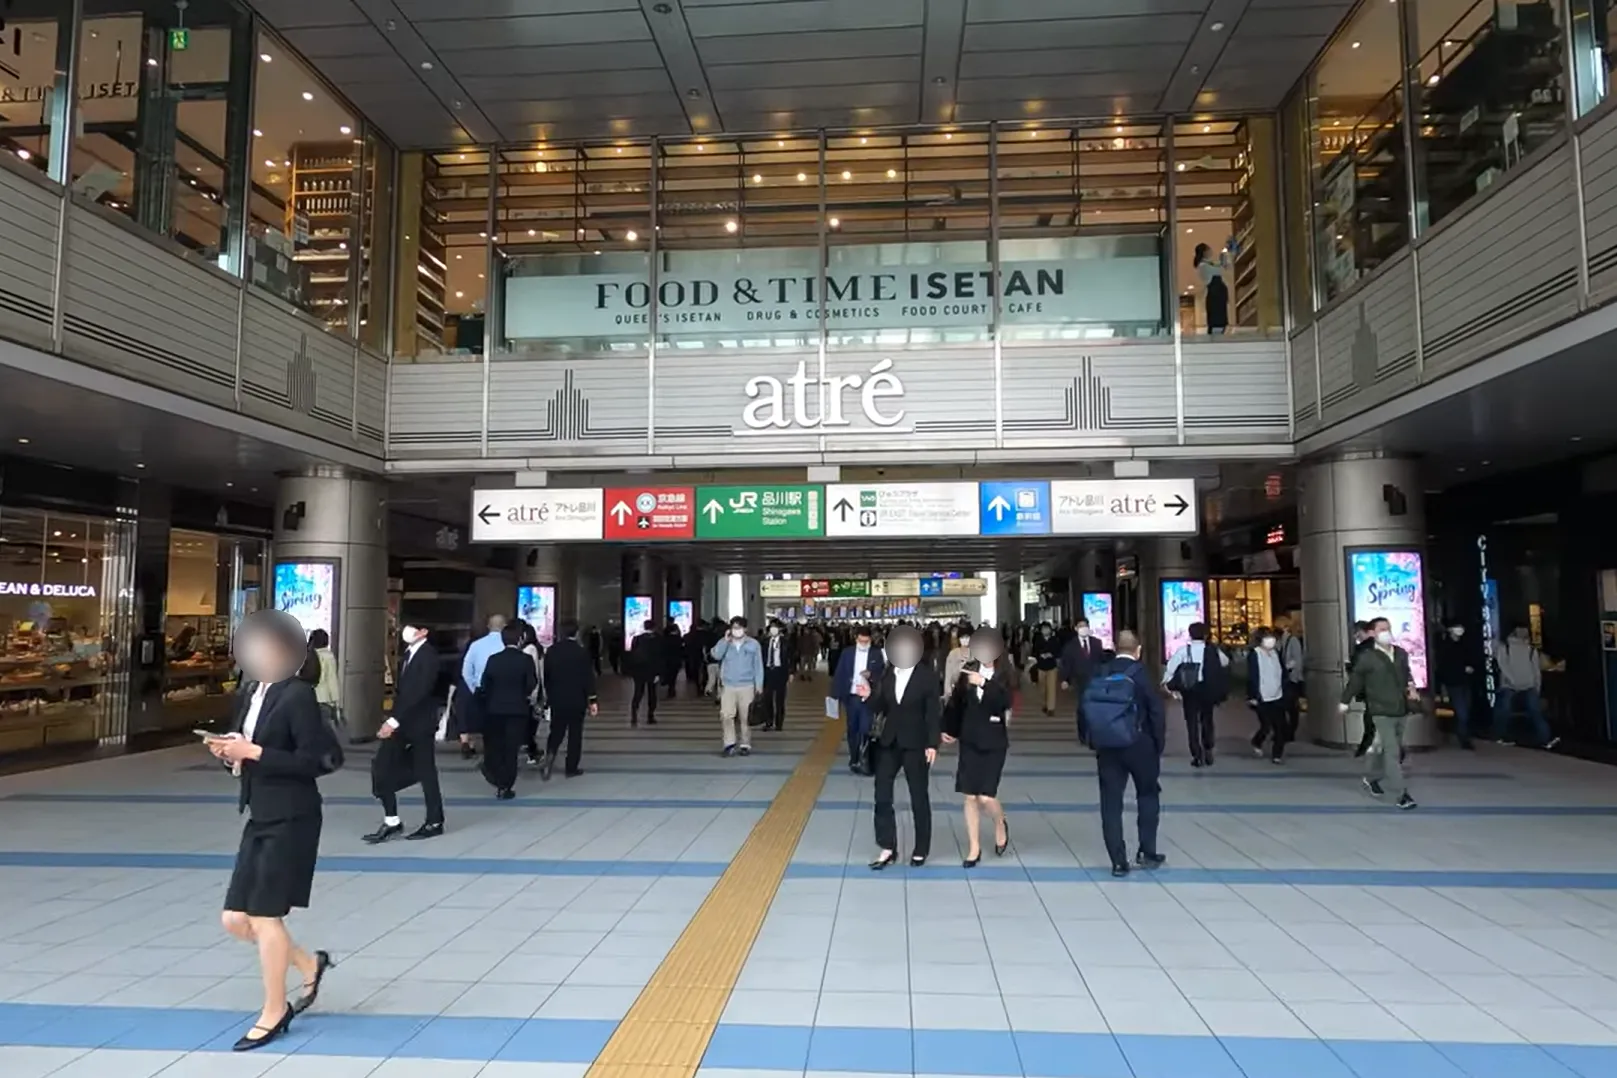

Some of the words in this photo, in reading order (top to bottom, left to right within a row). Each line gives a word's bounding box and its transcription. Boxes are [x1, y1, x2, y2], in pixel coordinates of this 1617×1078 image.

[594, 280, 719, 310] FOOD
[733, 278, 763, 305] &
[768, 273, 897, 304] TIME
[909, 269, 1064, 300] ISETAN
[747, 310, 782, 320] DRUG
[790, 310, 798, 320] &
[806, 307, 880, 319] COSMETICS
[902, 304, 938, 316] FOOD
[944, 304, 987, 316] COURT
[1008, 302, 1042, 314] CAFE
[615, 312, 670, 325] QUEE'S
[676, 312, 722, 323] ISETAN
[743, 358, 906, 429] atré
[729, 492, 758, 508] JR
[762, 491, 802, 506] 品川駅
[1110, 494, 1156, 514] atré
[507, 503, 550, 522] atré
[30, 583, 41, 595] &
[42, 584, 96, 597] DELUCA
[1367, 582, 1416, 606] Spring
[281, 591, 322, 612] Spring
